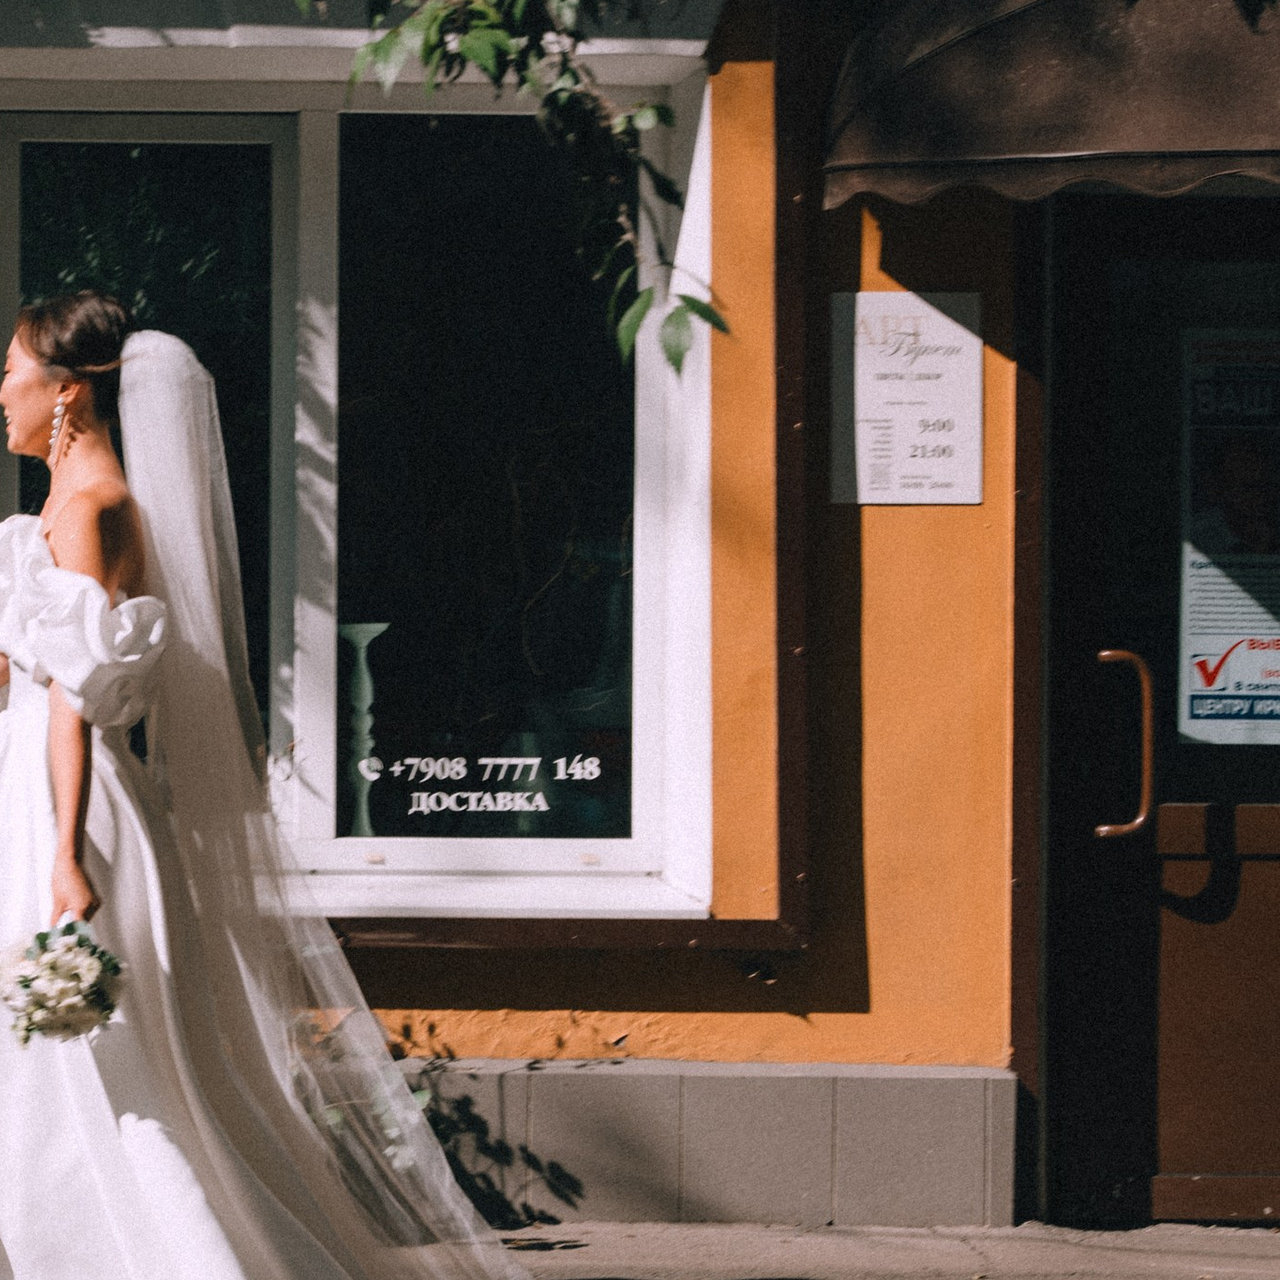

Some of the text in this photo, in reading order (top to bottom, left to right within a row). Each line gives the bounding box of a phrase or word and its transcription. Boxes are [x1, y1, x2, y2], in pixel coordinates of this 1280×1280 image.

[389, 753, 602, 784] +7908 7777 148
[408, 791, 551, 815] ДОСТАВКА
